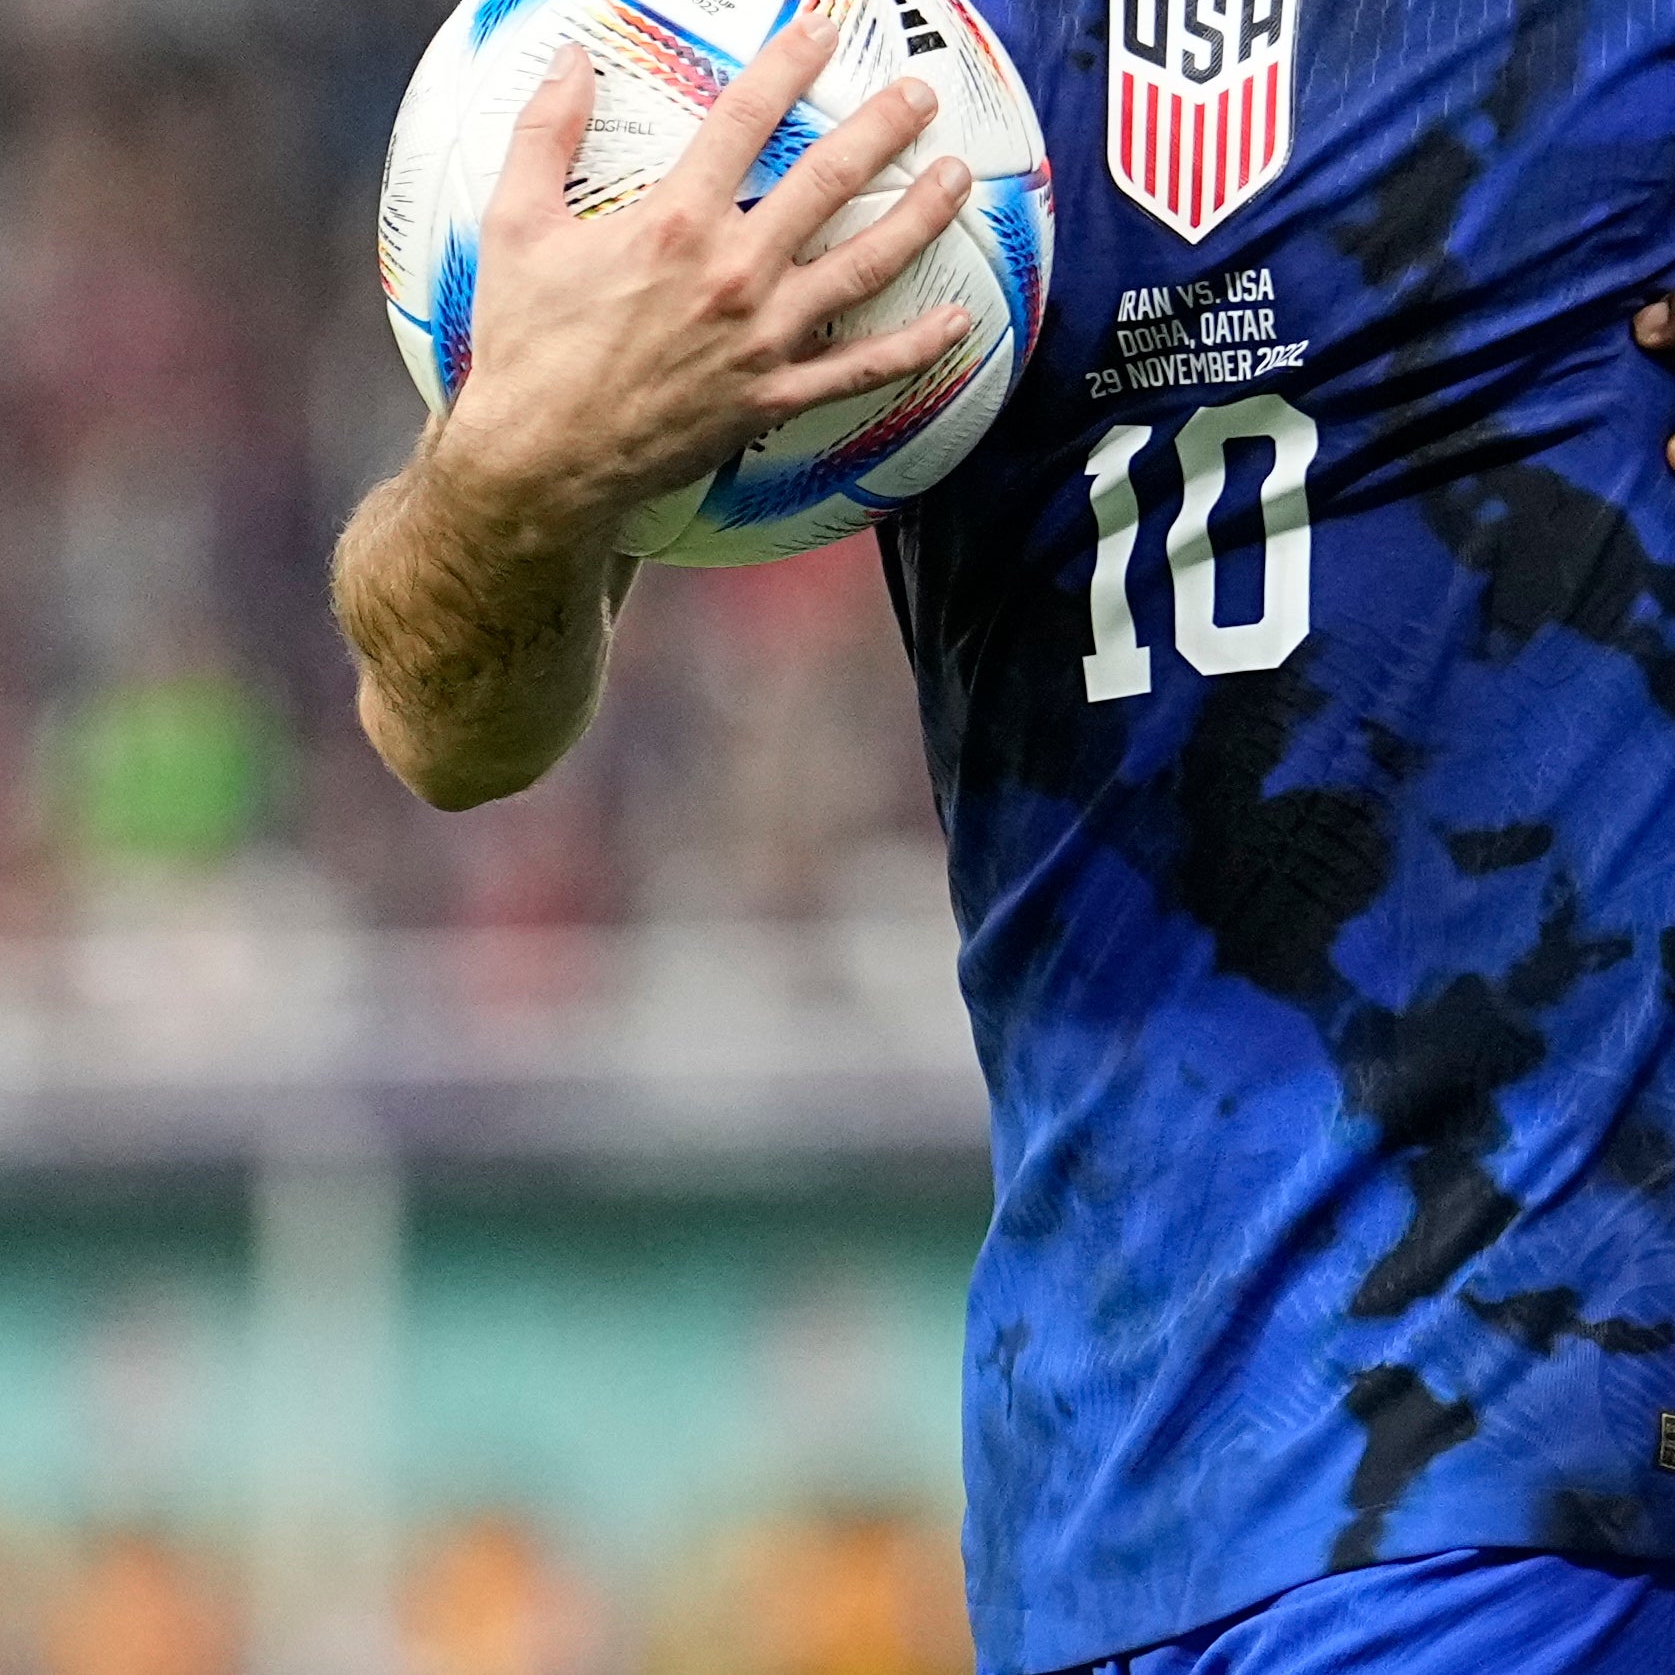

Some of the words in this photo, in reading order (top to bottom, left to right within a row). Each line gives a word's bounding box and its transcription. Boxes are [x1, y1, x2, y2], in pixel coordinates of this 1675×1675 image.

[585, 117, 655, 136] EDSHELL
[1117, 287, 1174, 322] IRAN
[1176, 280, 1222, 309] VS.
[1224, 268, 1275, 303] USA
[1117, 319, 1196, 358] DOHA,
[1200, 308, 1277, 347] QATAR
[1085, 368, 1124, 399] 29
[1125, 349, 1252, 389] NOVEMBER
[1253, 339, 1310, 377] 2022
[1082, 393, 1319, 703] 10
